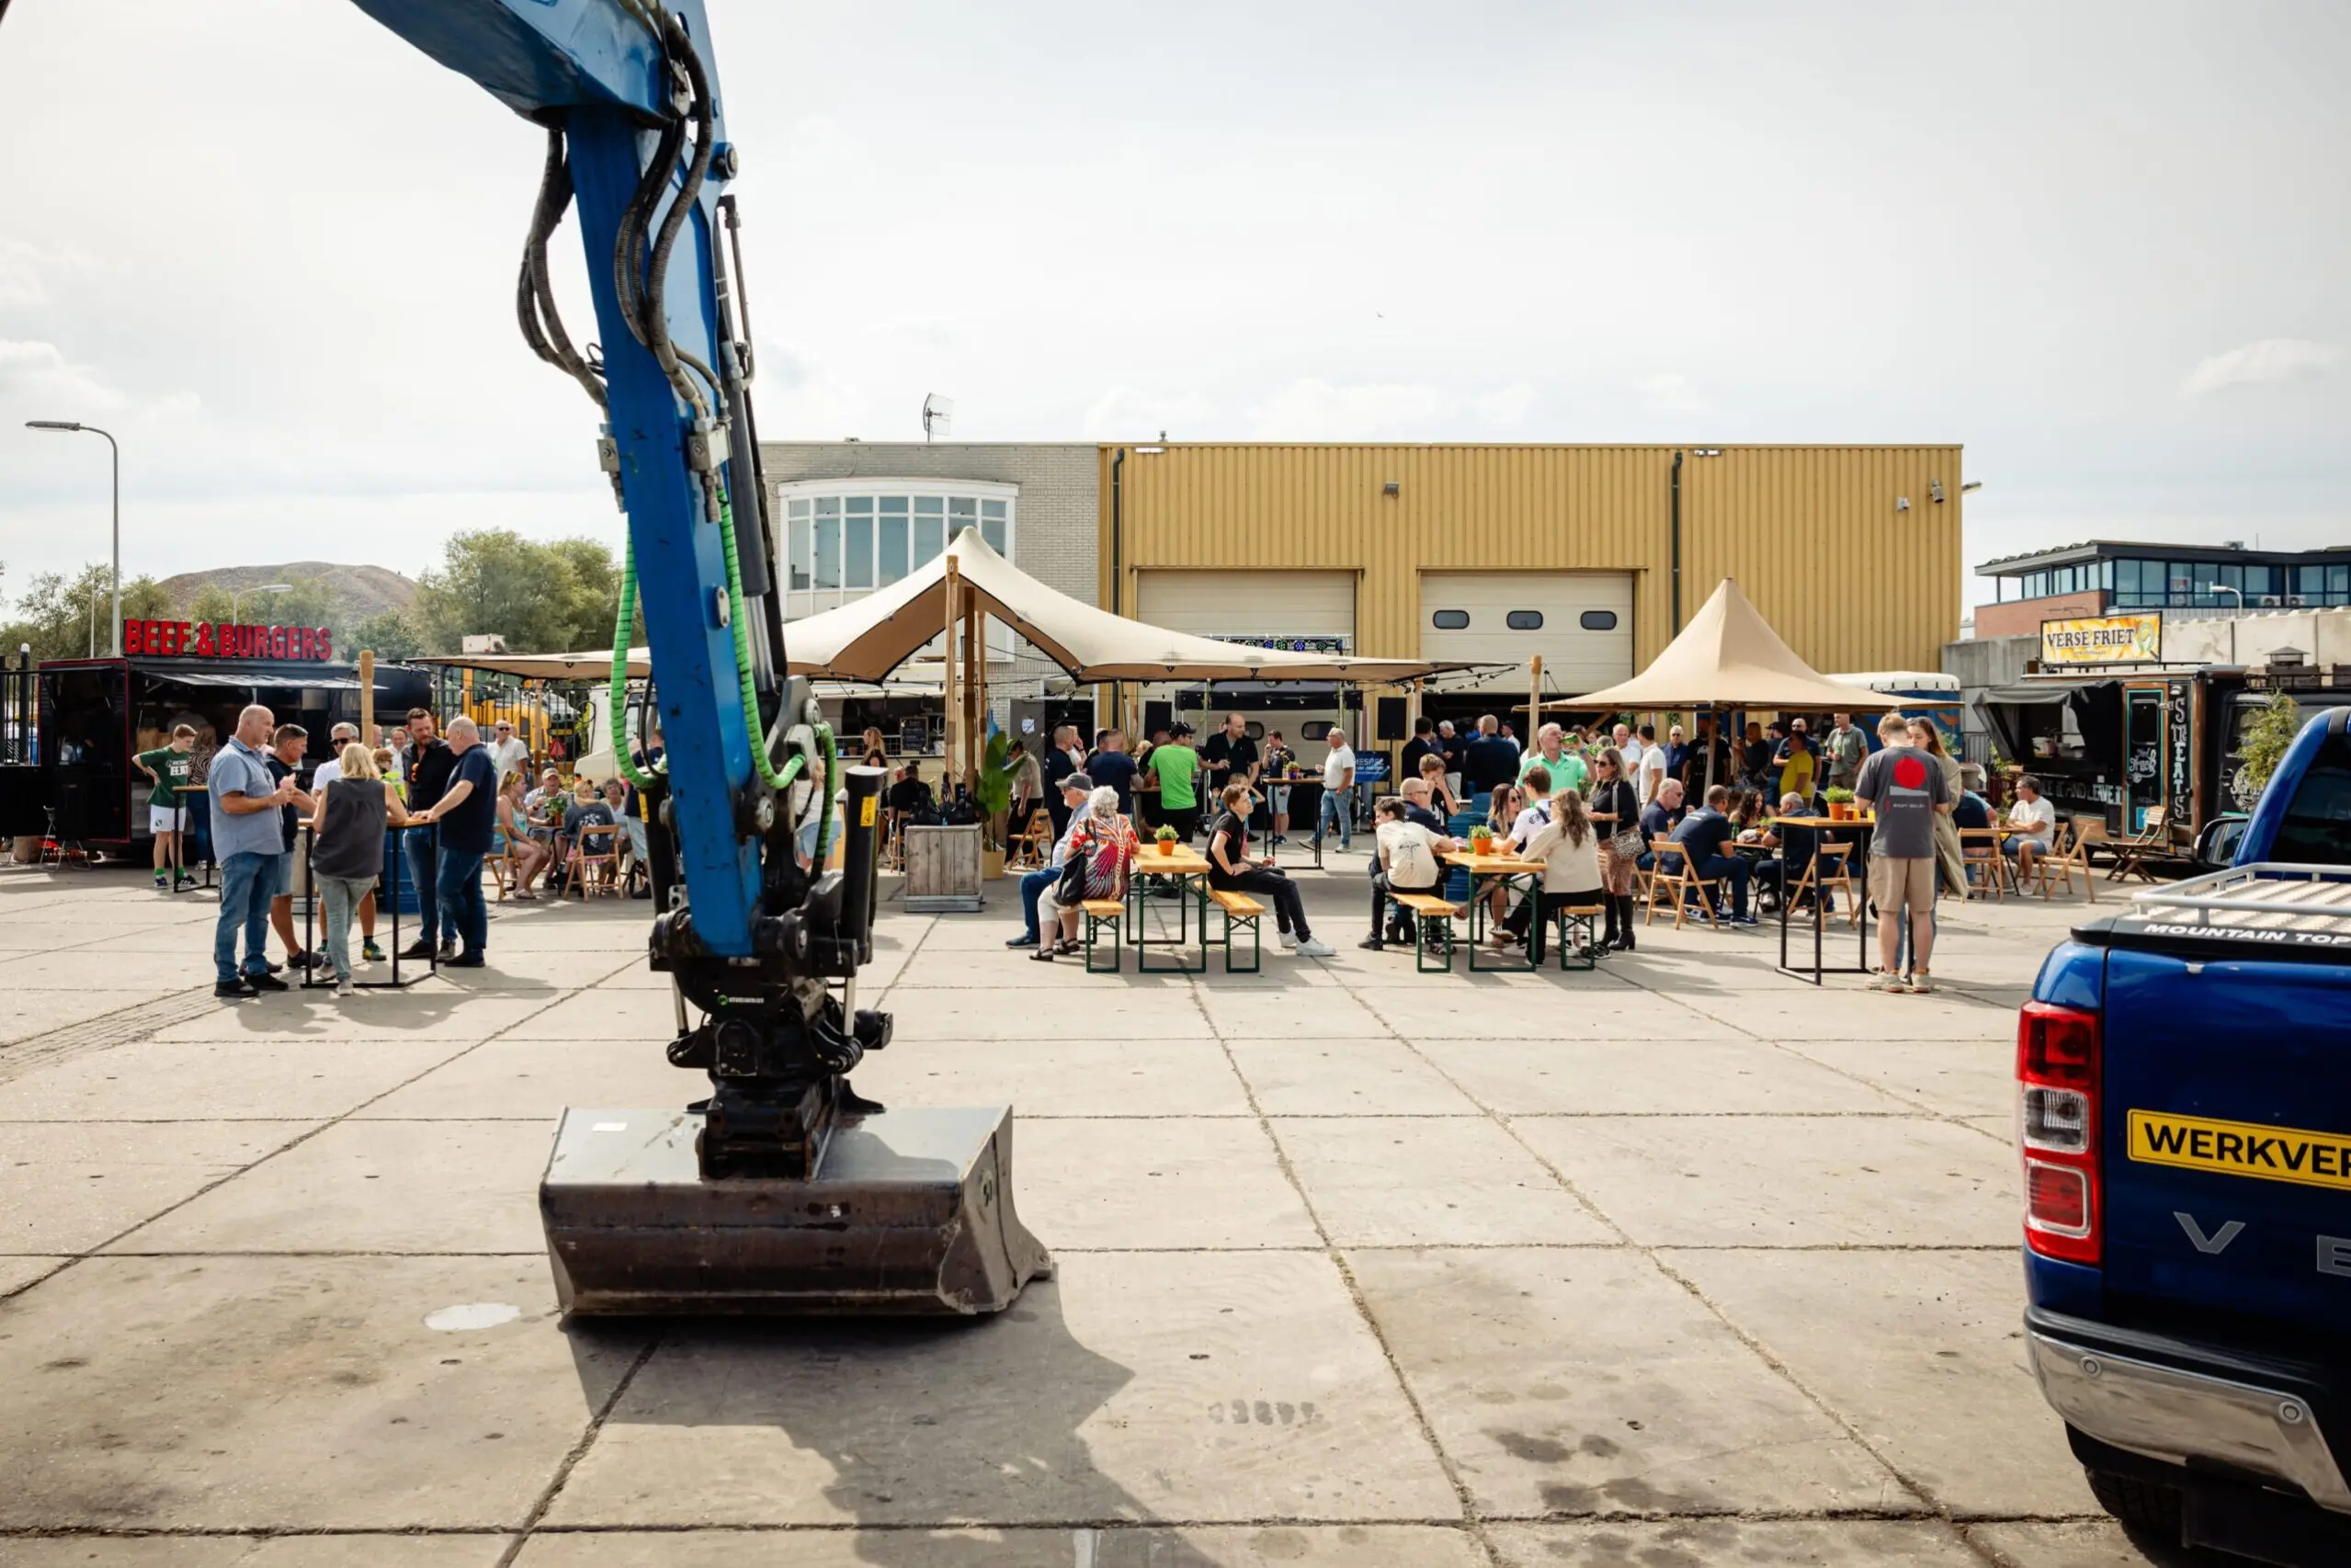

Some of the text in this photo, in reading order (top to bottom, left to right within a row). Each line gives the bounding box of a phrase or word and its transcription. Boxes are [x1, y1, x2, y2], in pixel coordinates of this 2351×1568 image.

[124, 619, 333, 660] BEEF & BURGERS
[2047, 629, 2134, 647] VERSE FRIET
[2143, 924, 2351, 946] MOUNTAIN TOP
